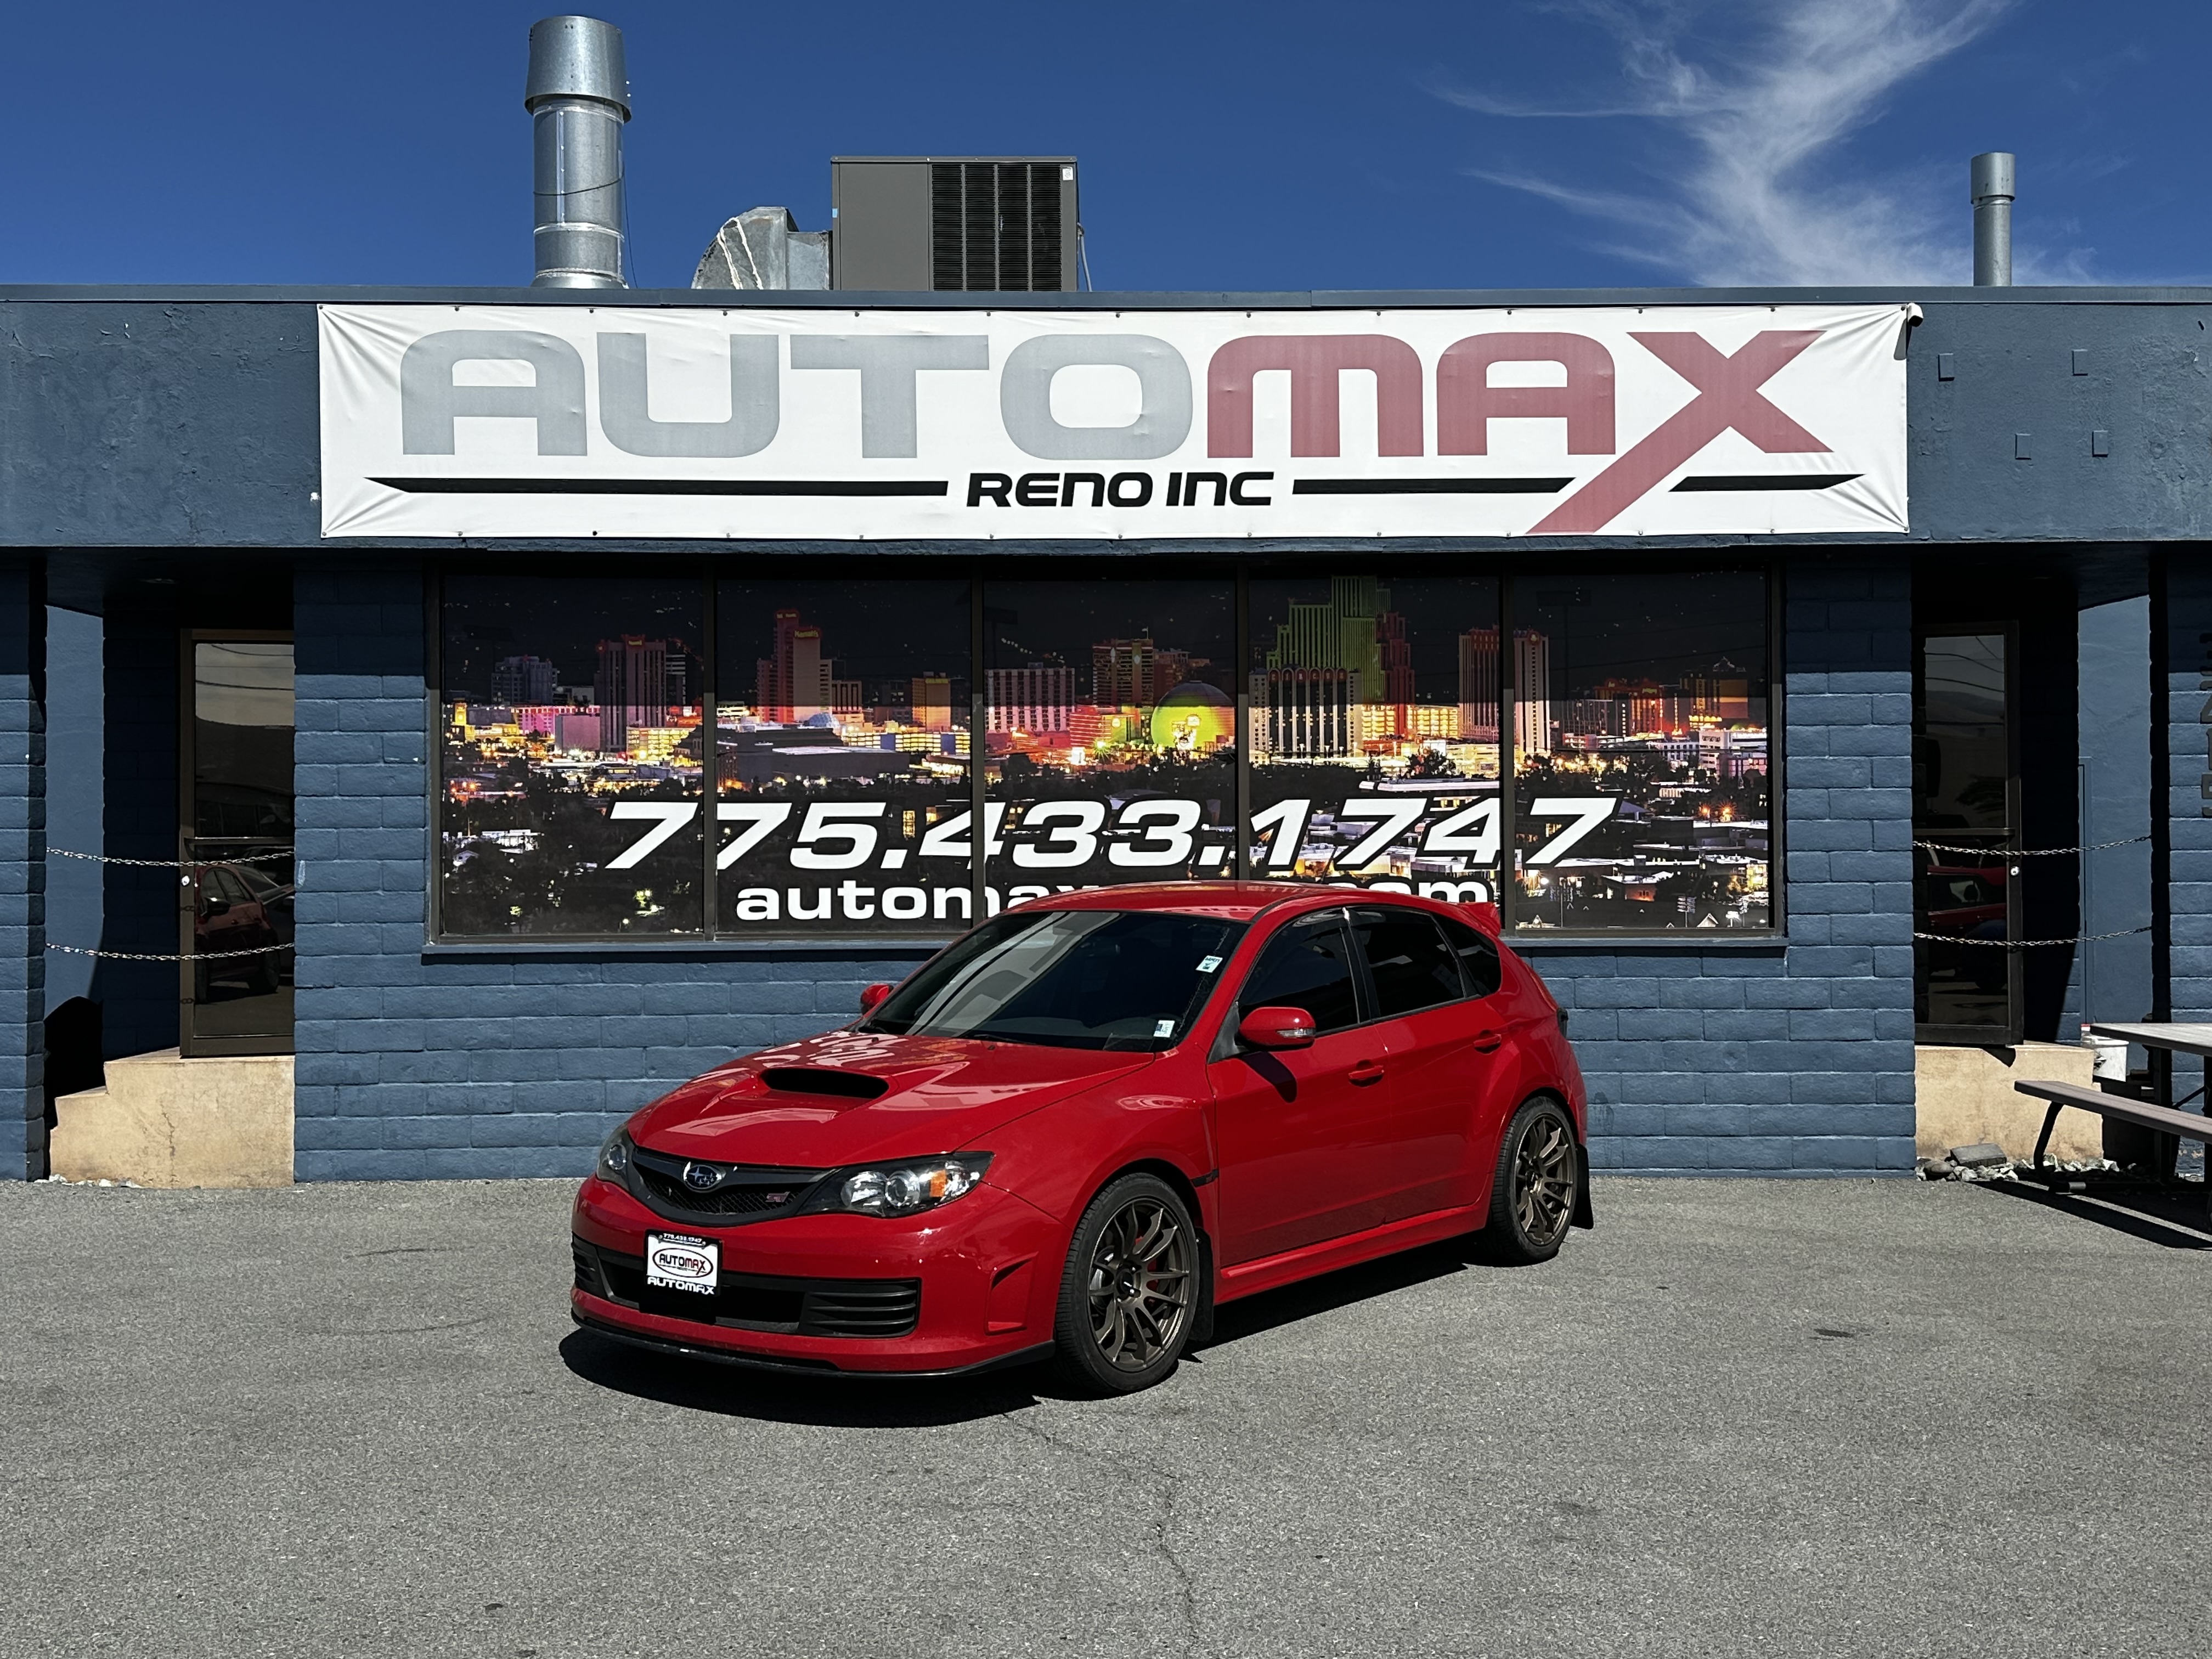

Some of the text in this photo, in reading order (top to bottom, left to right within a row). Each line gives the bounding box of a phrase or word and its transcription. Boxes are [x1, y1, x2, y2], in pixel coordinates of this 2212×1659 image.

[400, 330, 1834, 534] AUTOMAX
[967, 471, 1274, 507] RENO INC
[605, 798, 1616, 870] 775.433.1747
[659, 1253, 706, 1276] AUTOMAX
[647, 1276, 715, 1295] AUTOMAX
